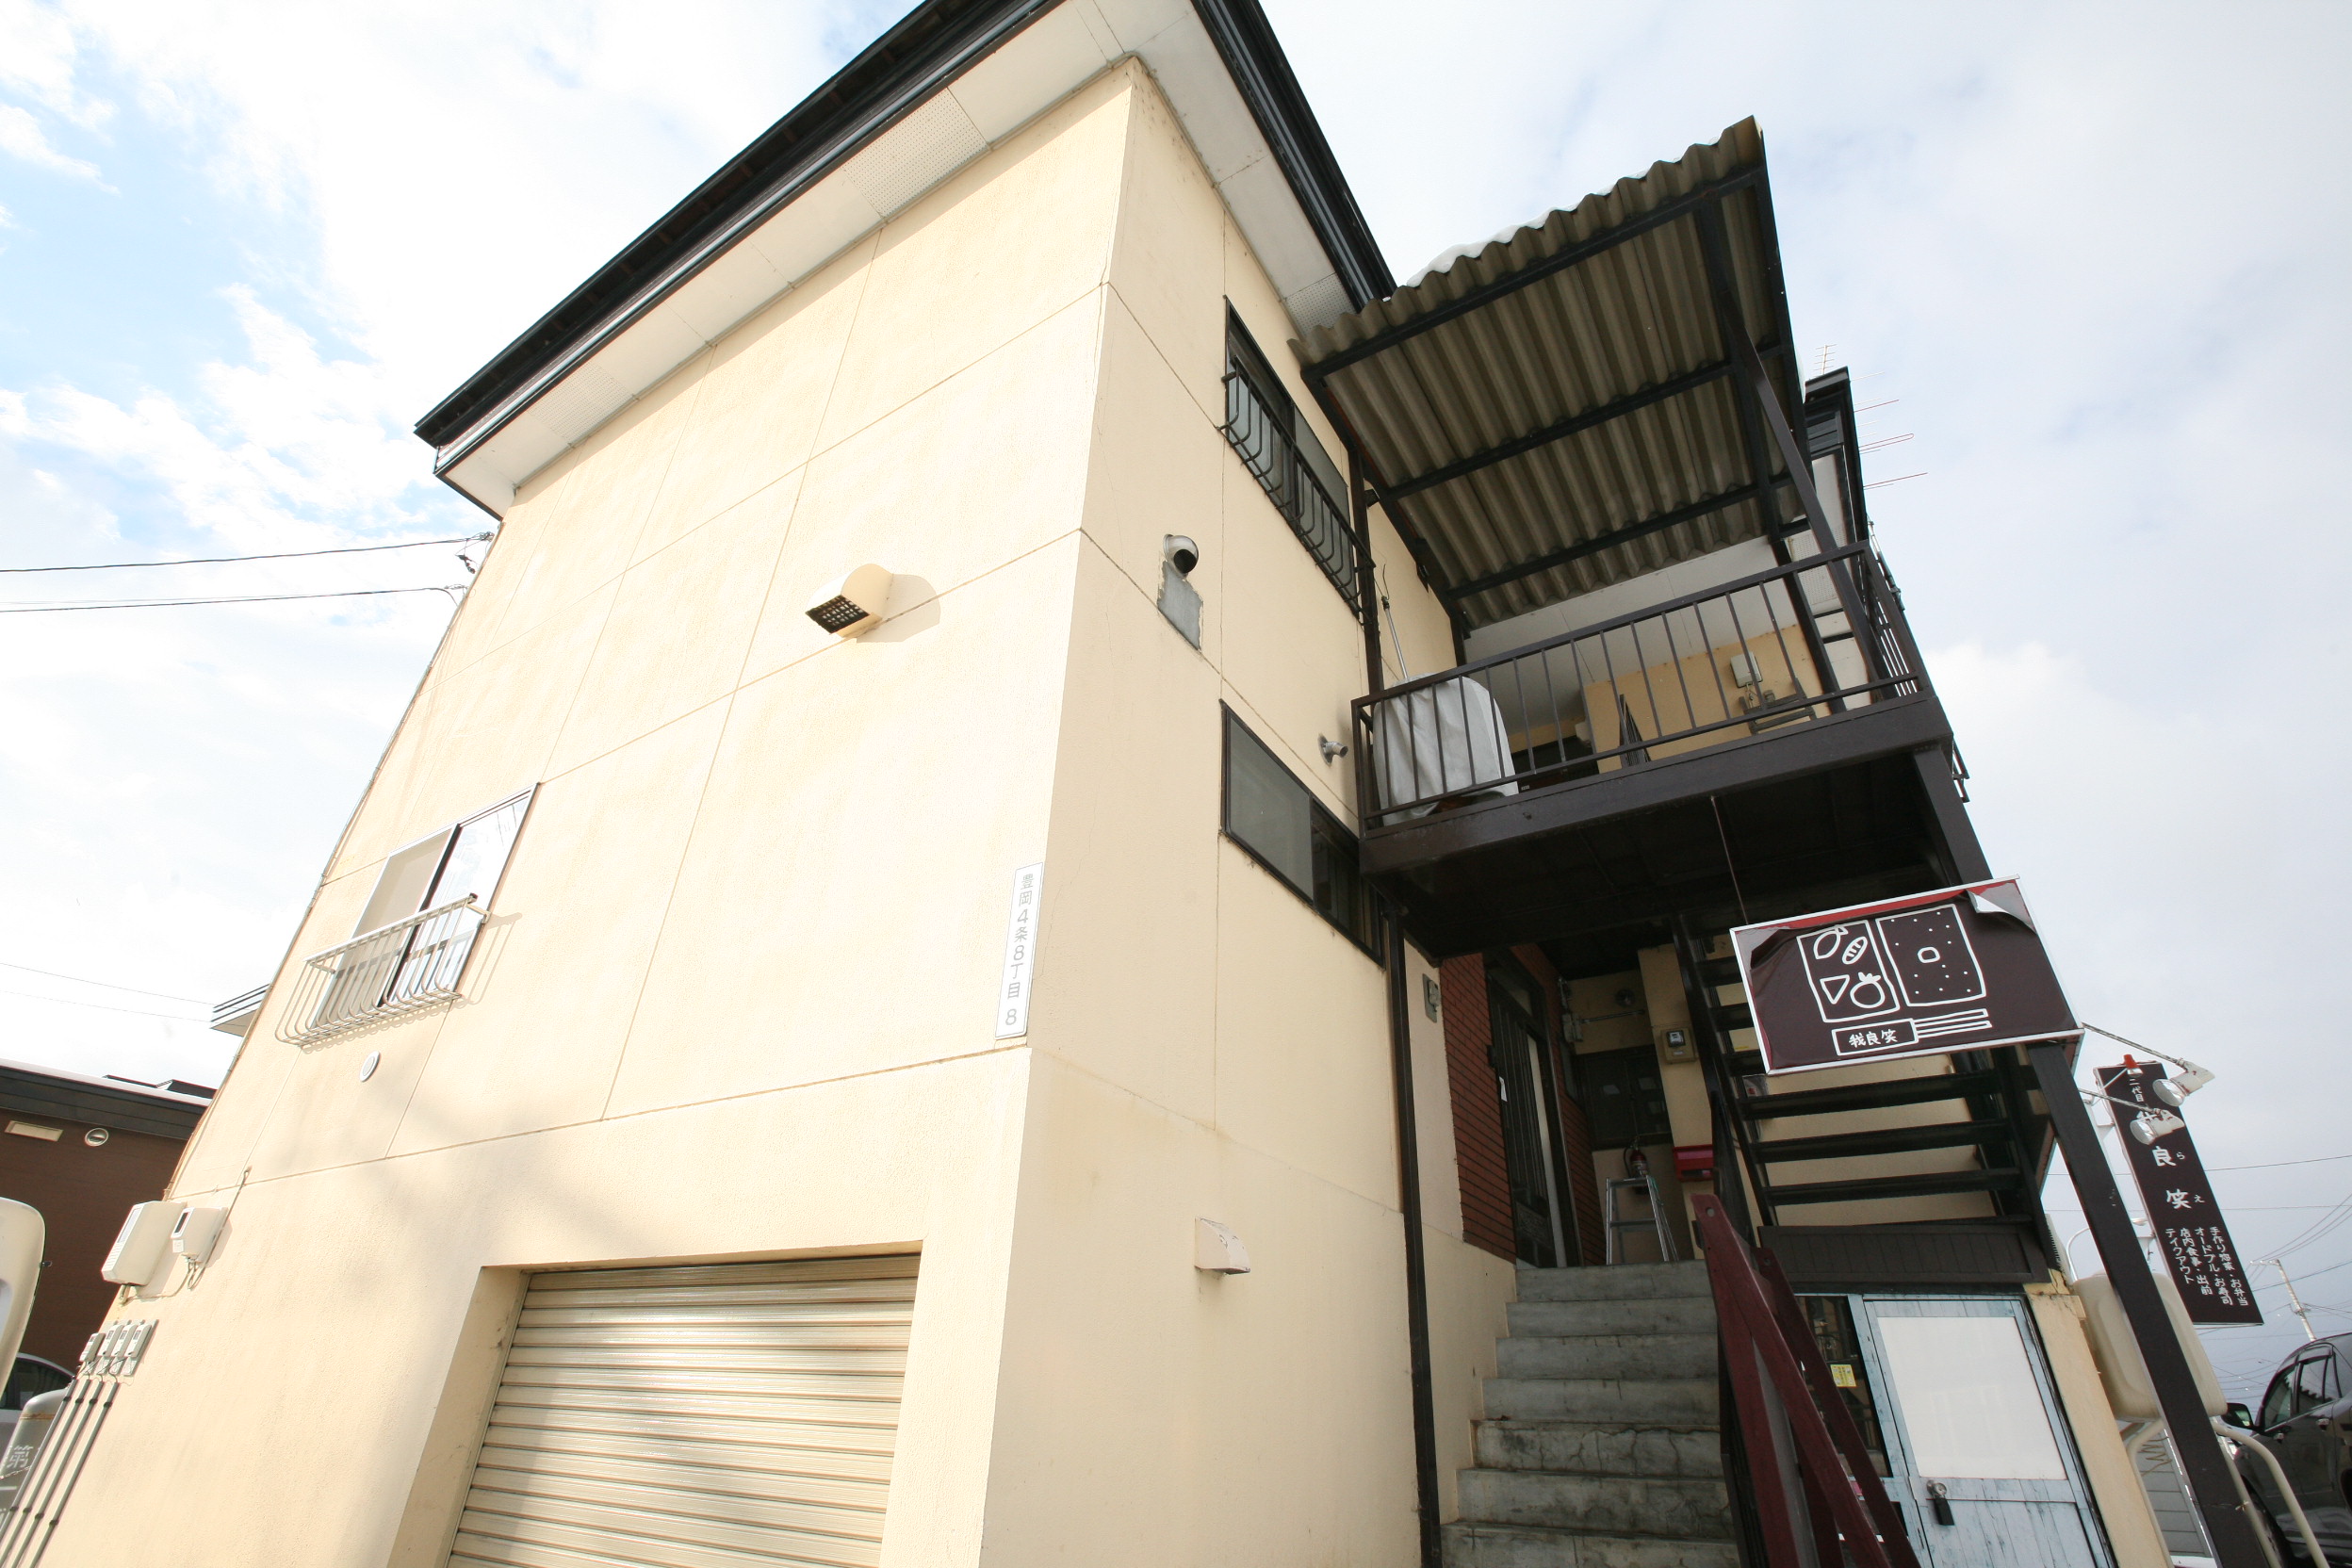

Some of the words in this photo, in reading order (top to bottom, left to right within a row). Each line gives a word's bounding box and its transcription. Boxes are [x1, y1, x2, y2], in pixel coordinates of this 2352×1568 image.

[1848, 1029, 1898, 1048] 我良笑
[2129, 1078, 2144, 1102] 二代目
[2165, 1228, 2195, 1284] テイクアウト
